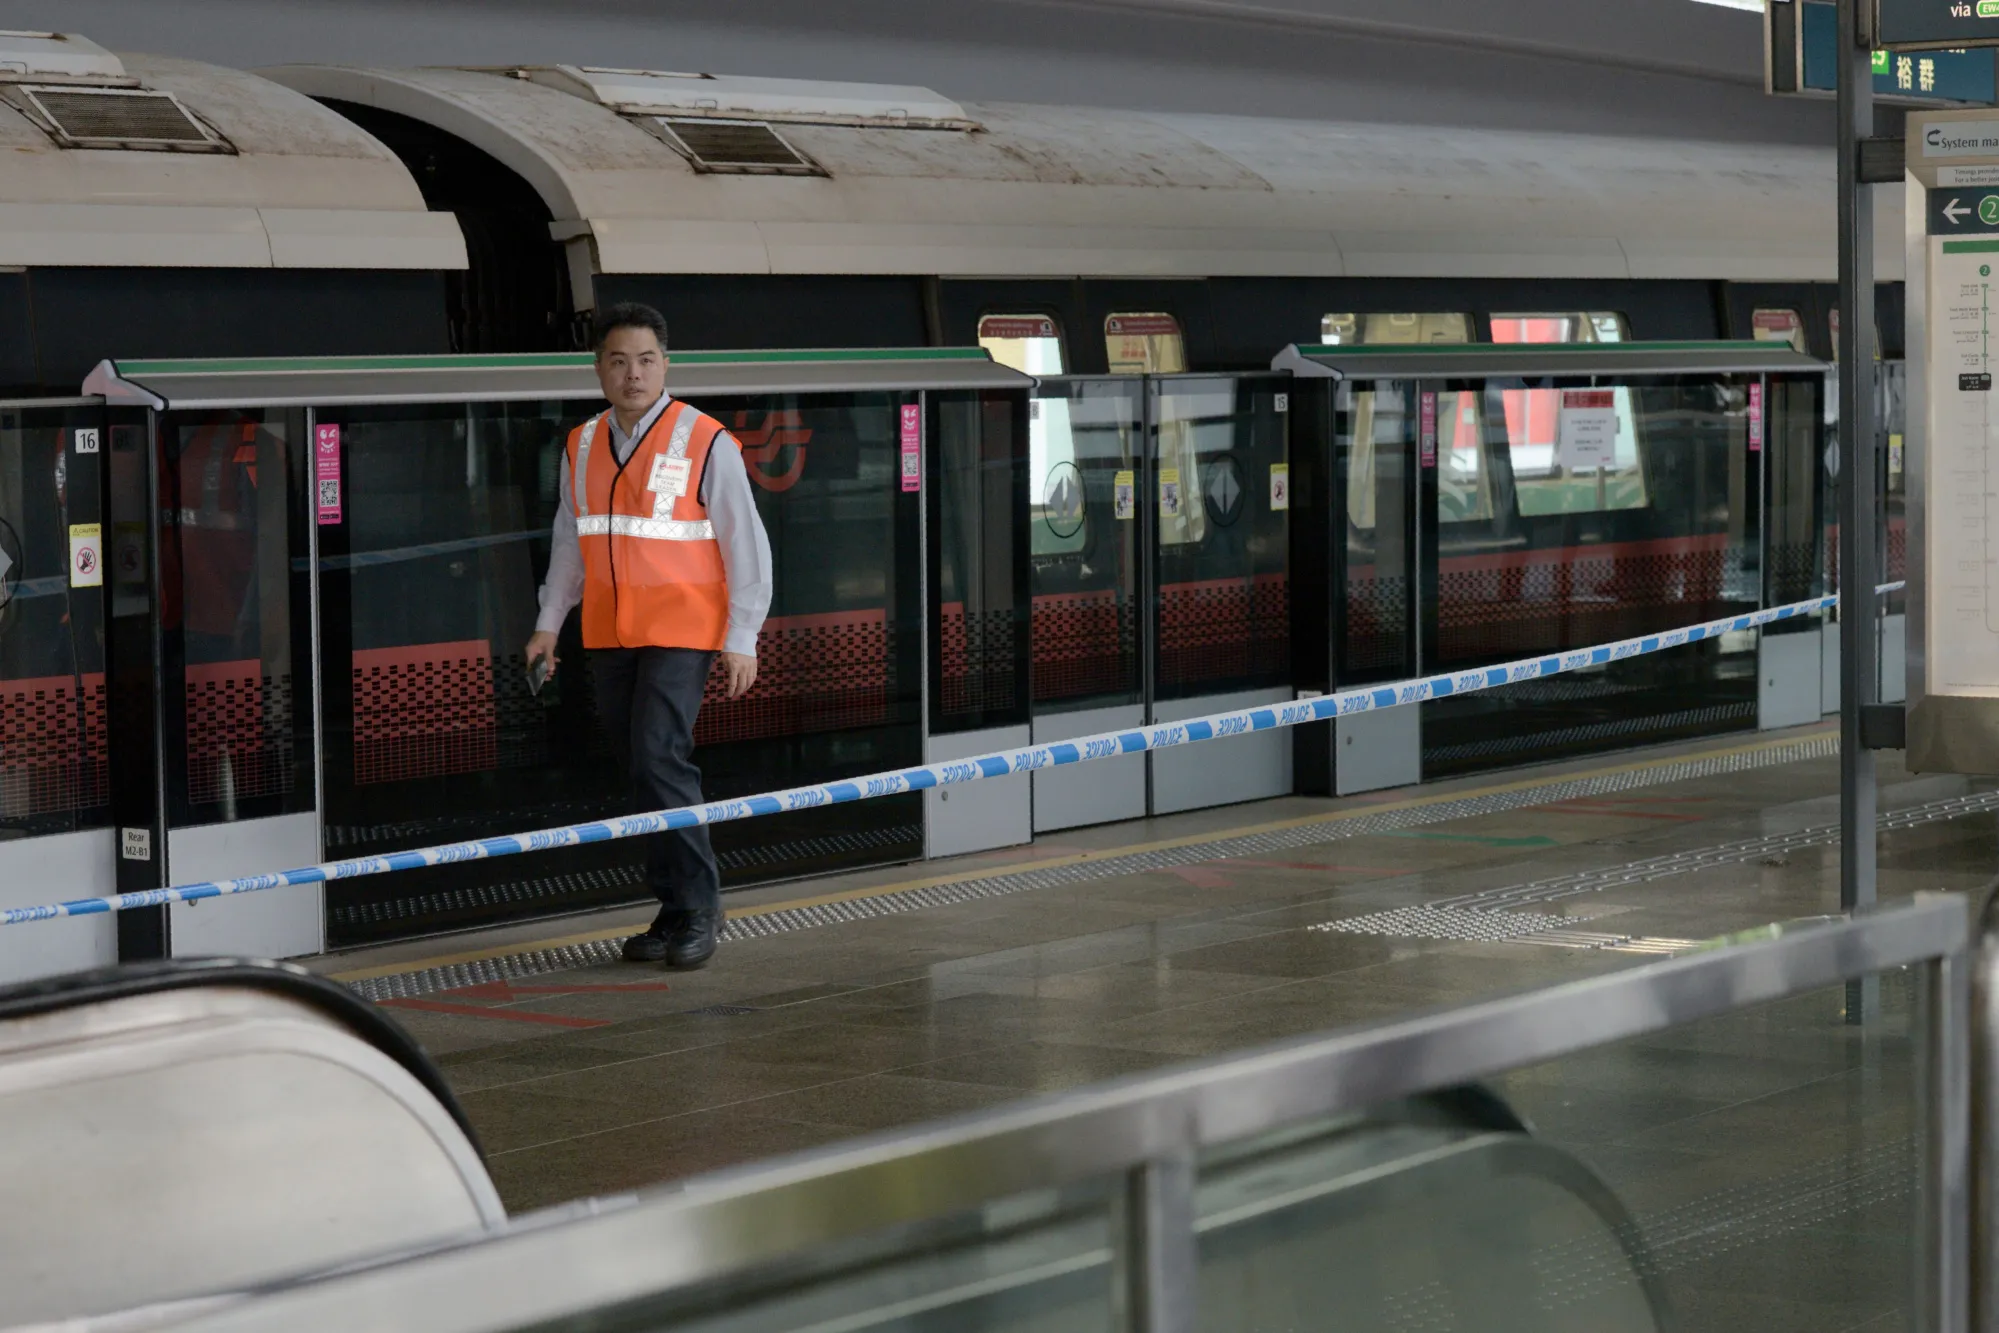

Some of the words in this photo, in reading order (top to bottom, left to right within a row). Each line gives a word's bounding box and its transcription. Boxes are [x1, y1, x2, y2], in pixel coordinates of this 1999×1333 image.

[1950, 2, 1971, 17] via
[1941, 137, 1979, 151] System
[1987, 201, 1997, 218] 2
[80, 432, 96, 450] 16
[1511, 663, 1538, 681] POLICE
[1401, 683, 1428, 702] POLICE
[1279, 704, 1310, 724] POLICE
[1216, 716, 1248, 737] POLICE
[1151, 727, 1183, 747] POLICE
[1084, 738, 1117, 760] POLICE
[1013, 750, 1047, 772] POLICE
[941, 763, 976, 784] POLICE
[866, 776, 903, 797] POLICE
[788, 788, 825, 809] POLICE
[706, 802, 744, 822] POLICE
[128, 831, 145, 842] Rear
[125, 845, 148, 857] M2-B1
